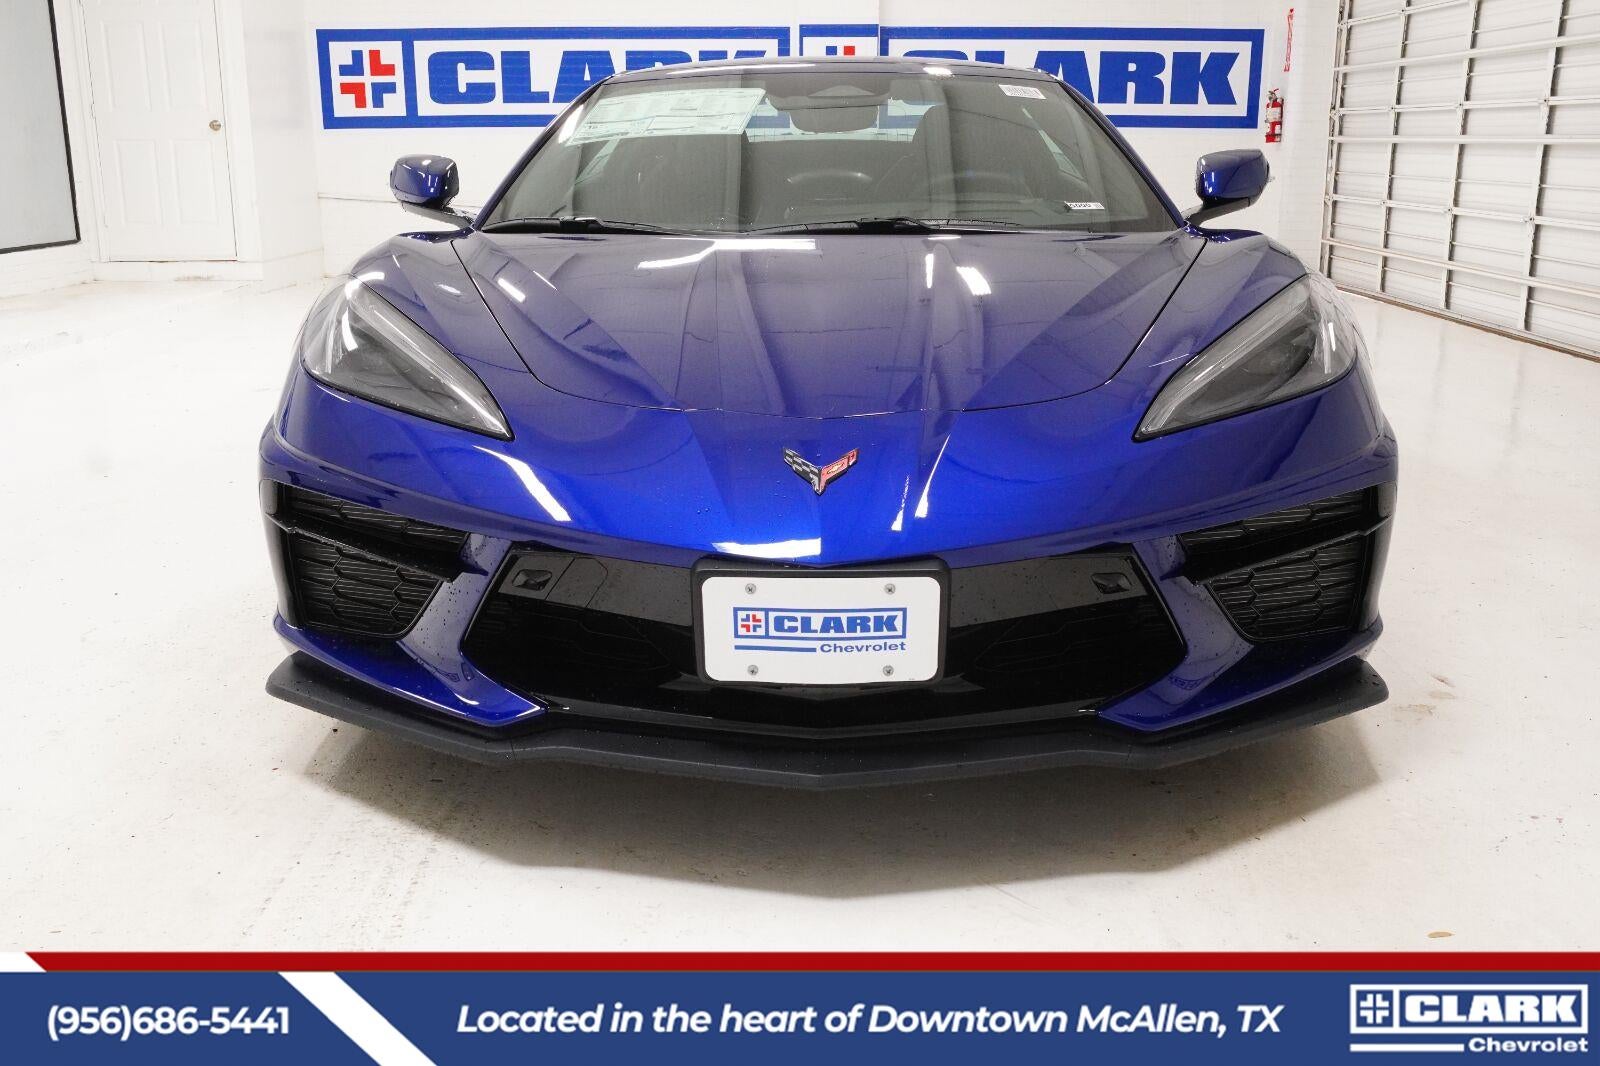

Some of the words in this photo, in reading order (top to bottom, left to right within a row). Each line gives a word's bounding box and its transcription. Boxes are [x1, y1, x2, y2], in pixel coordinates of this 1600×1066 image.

[427, 50, 767, 106] CLA
[902, 49, 1240, 106] ARK
[773, 615, 898, 634] CLARK
[819, 642, 907, 653] Chevrolet
